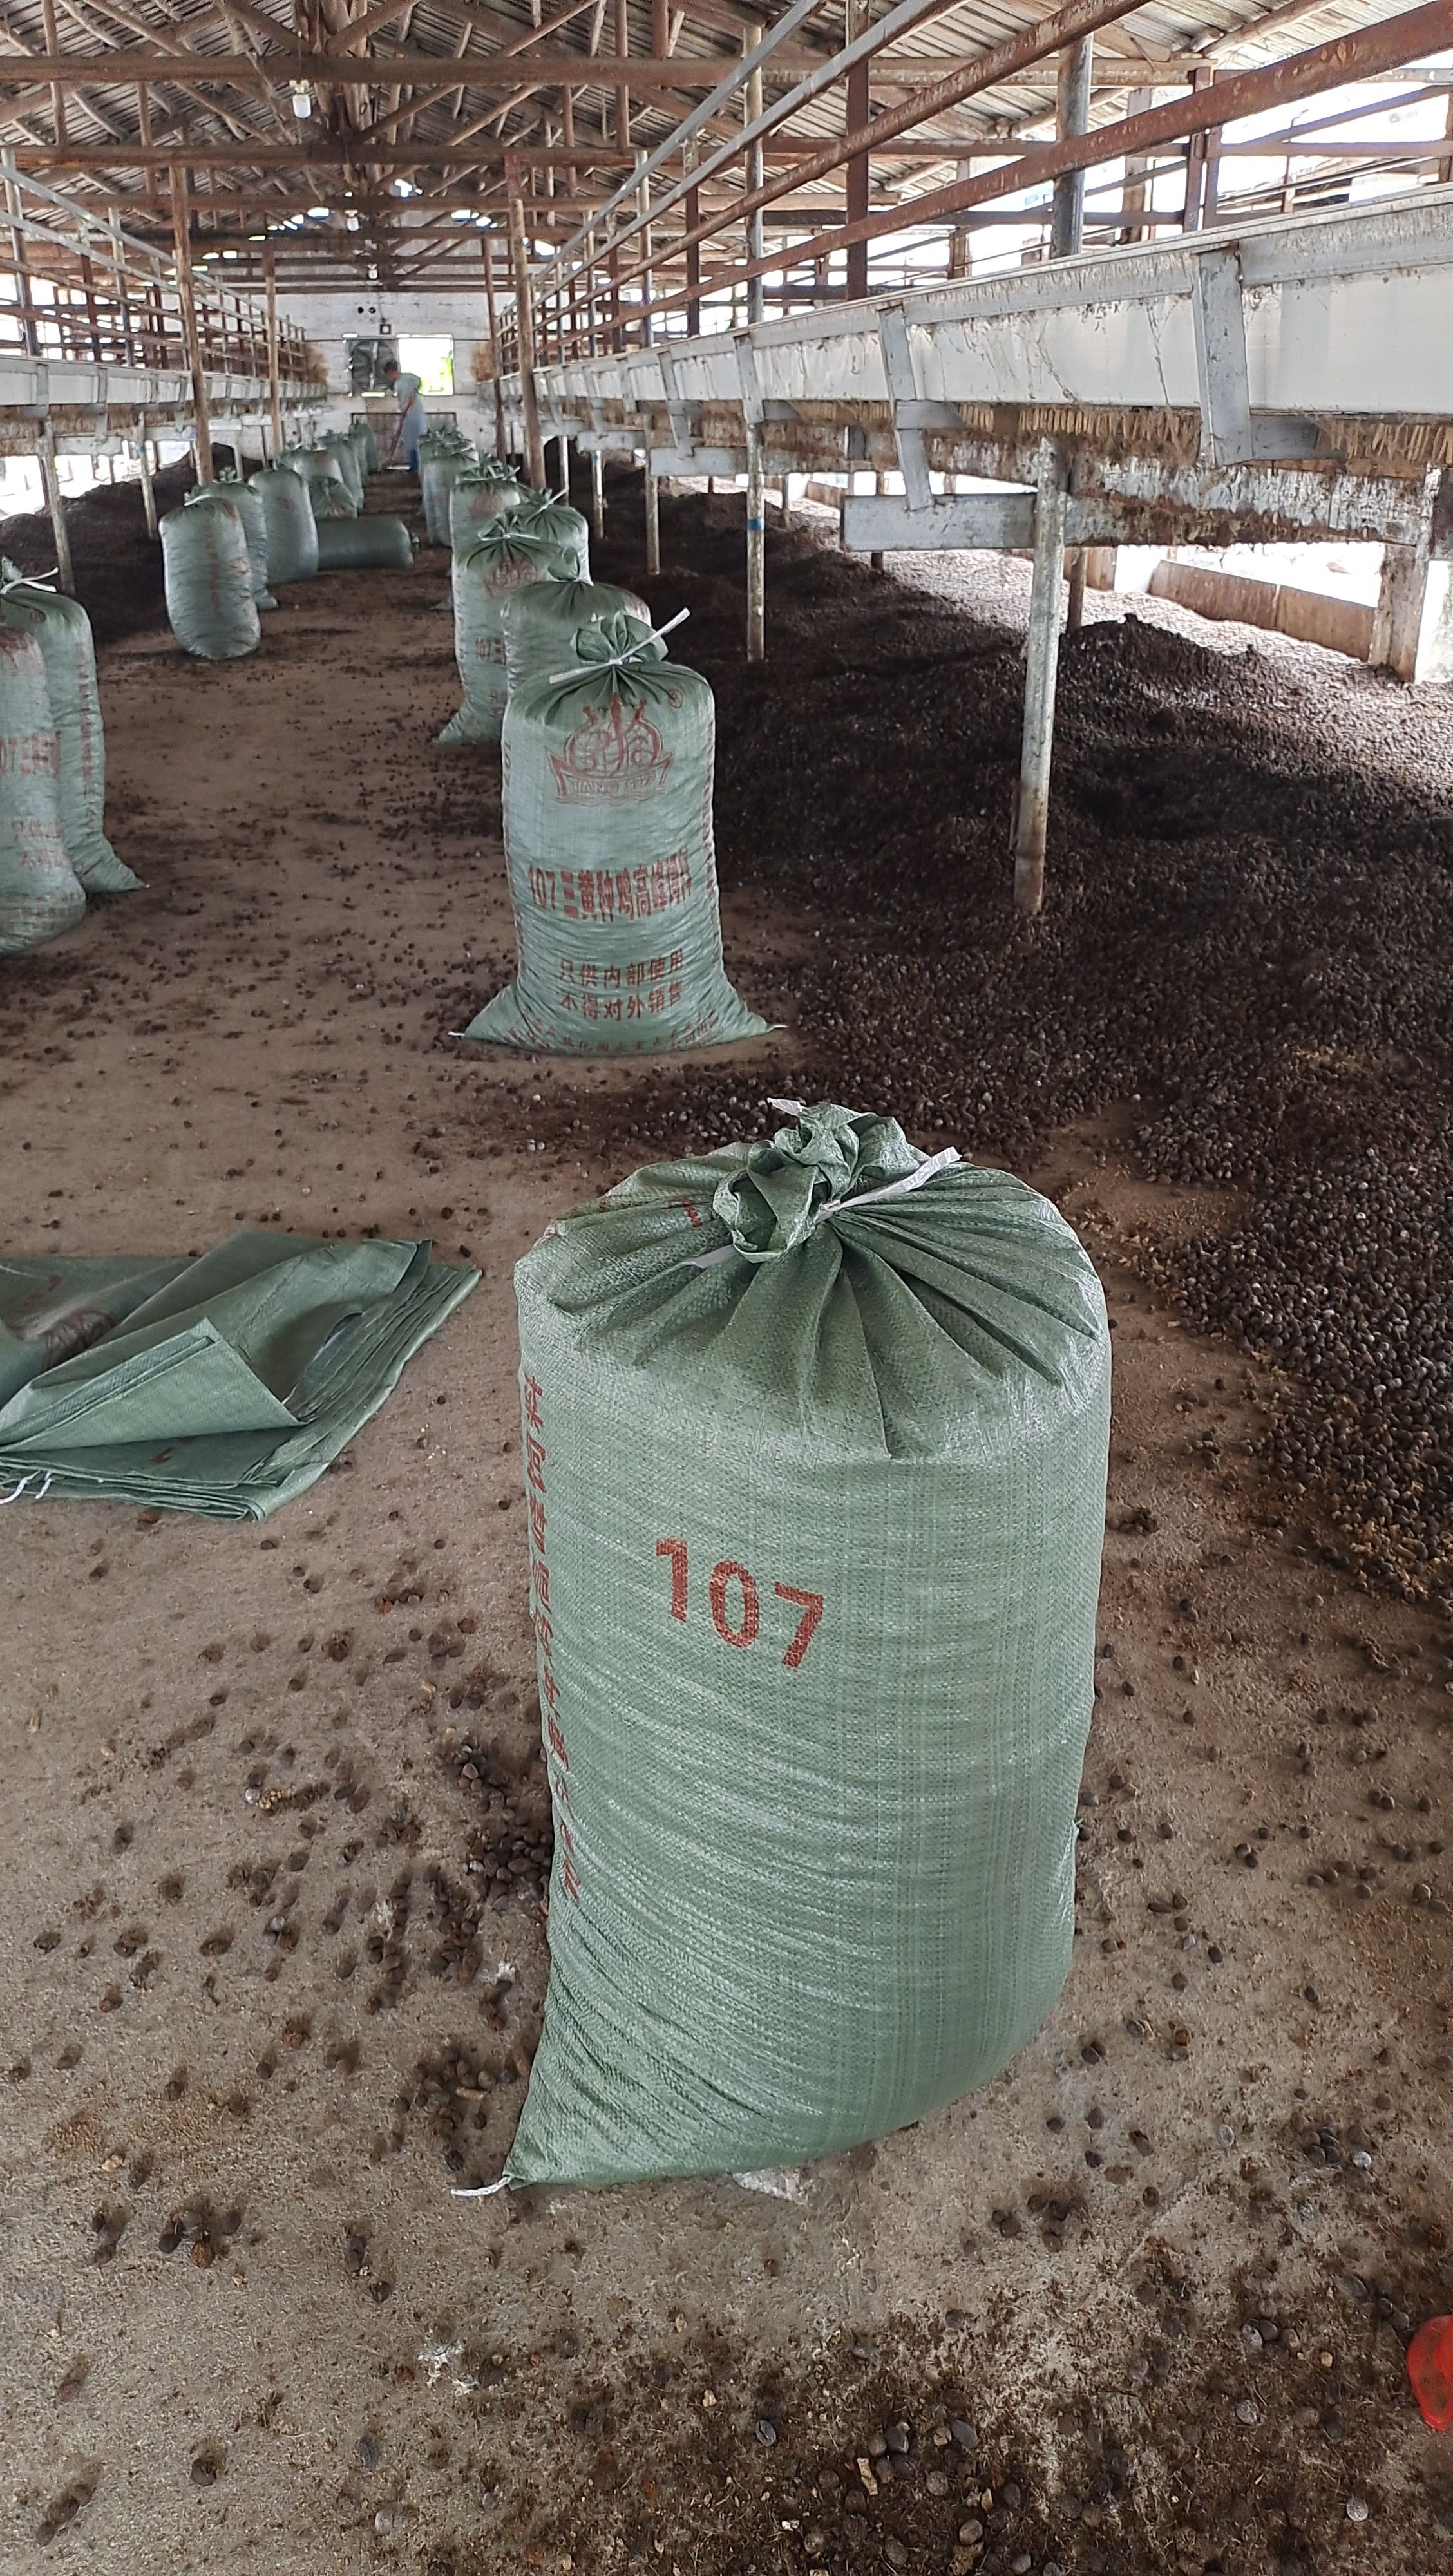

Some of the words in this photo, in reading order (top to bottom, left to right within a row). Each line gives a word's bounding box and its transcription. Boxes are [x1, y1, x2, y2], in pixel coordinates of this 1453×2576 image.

[558, 947, 684, 989] 只供内部使用
[560, 979, 683, 1021] 不得对外销售
[656, 1536, 824, 1668] 107
